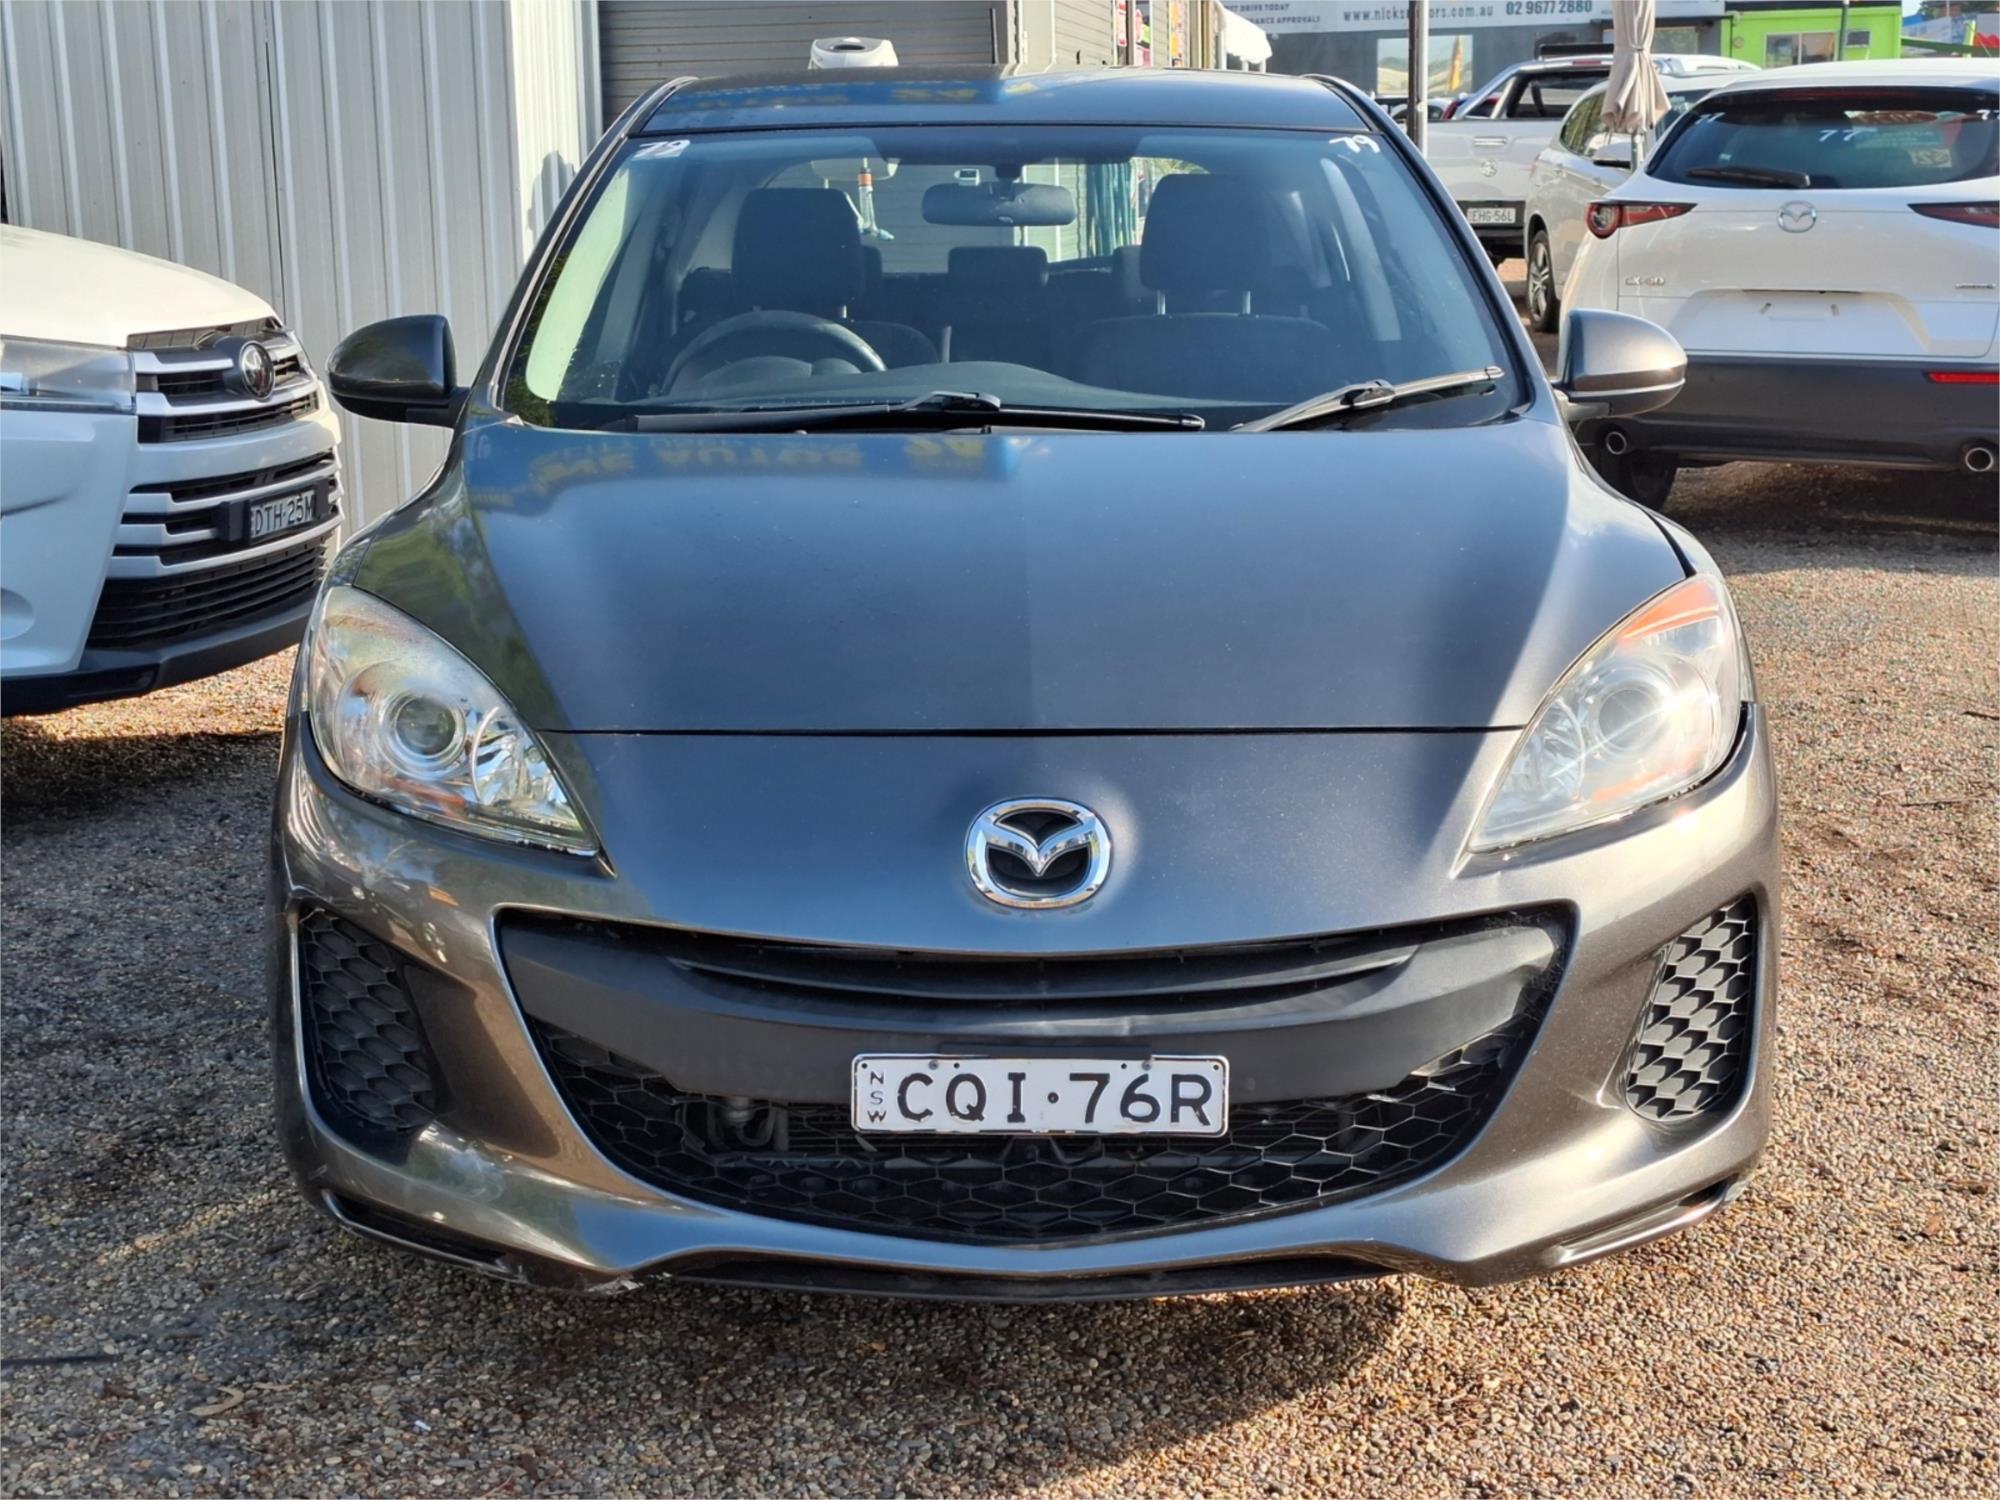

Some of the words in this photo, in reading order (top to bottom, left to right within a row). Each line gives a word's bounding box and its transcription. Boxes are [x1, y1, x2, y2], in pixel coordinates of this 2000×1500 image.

[1343, 5, 1493, 21] www.nicksors.com.au
[1506, 2, 1522, 15] 02
[1526, 1, 1555, 14] 9677
[1328, 135, 1380, 153] 79
